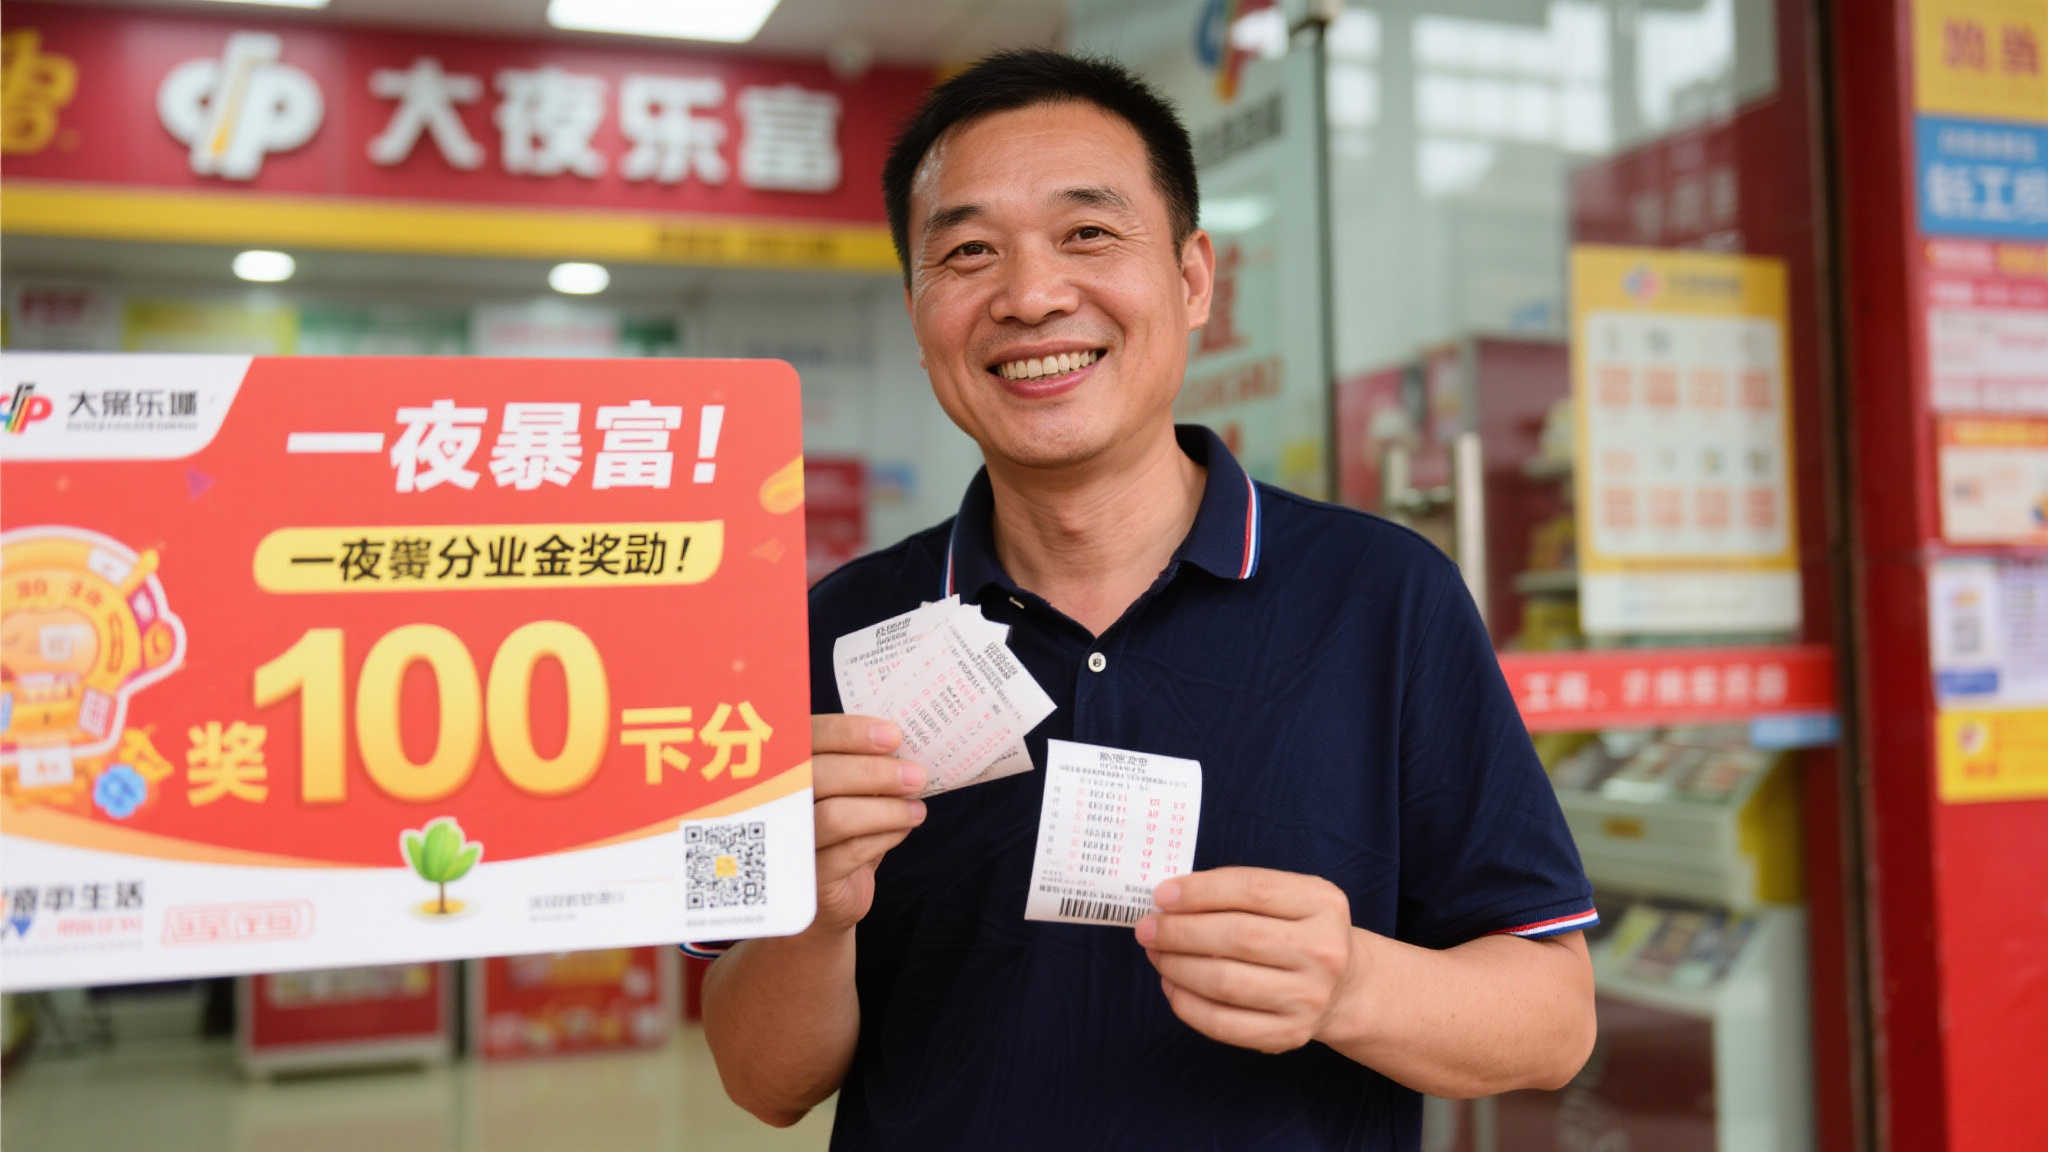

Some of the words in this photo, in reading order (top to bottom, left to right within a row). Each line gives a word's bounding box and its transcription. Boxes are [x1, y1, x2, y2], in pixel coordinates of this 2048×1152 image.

[287, 400, 725, 493] 一夜暴富！
[186, 721, 270, 806] 奖
[252, 620, 611, 805] 100
